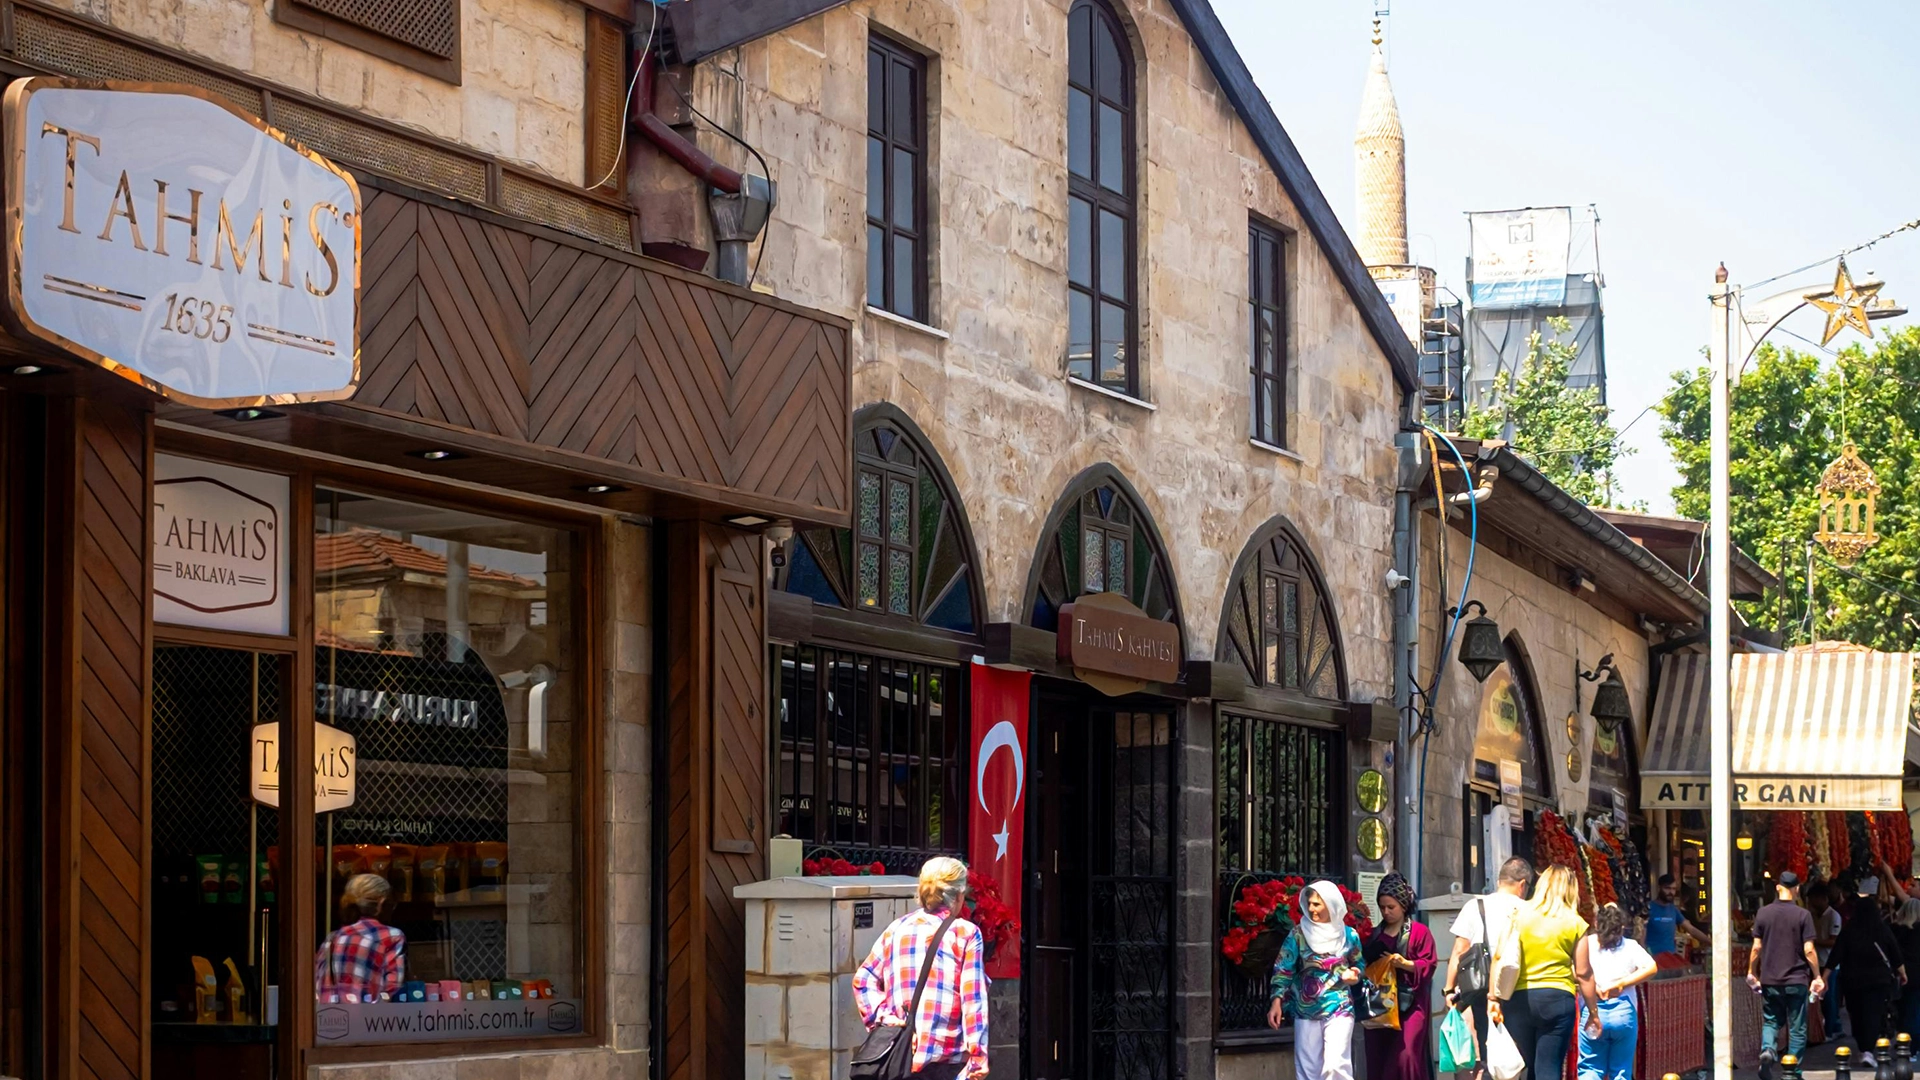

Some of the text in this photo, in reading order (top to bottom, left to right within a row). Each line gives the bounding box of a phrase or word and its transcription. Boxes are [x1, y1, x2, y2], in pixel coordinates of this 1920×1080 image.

[160, 292, 234, 343] 1635
[175, 561, 237, 586] BAKLAVA
[1658, 783, 1749, 802] ATTR
[364, 1007, 535, 1033] www.tahmis.com.tr
